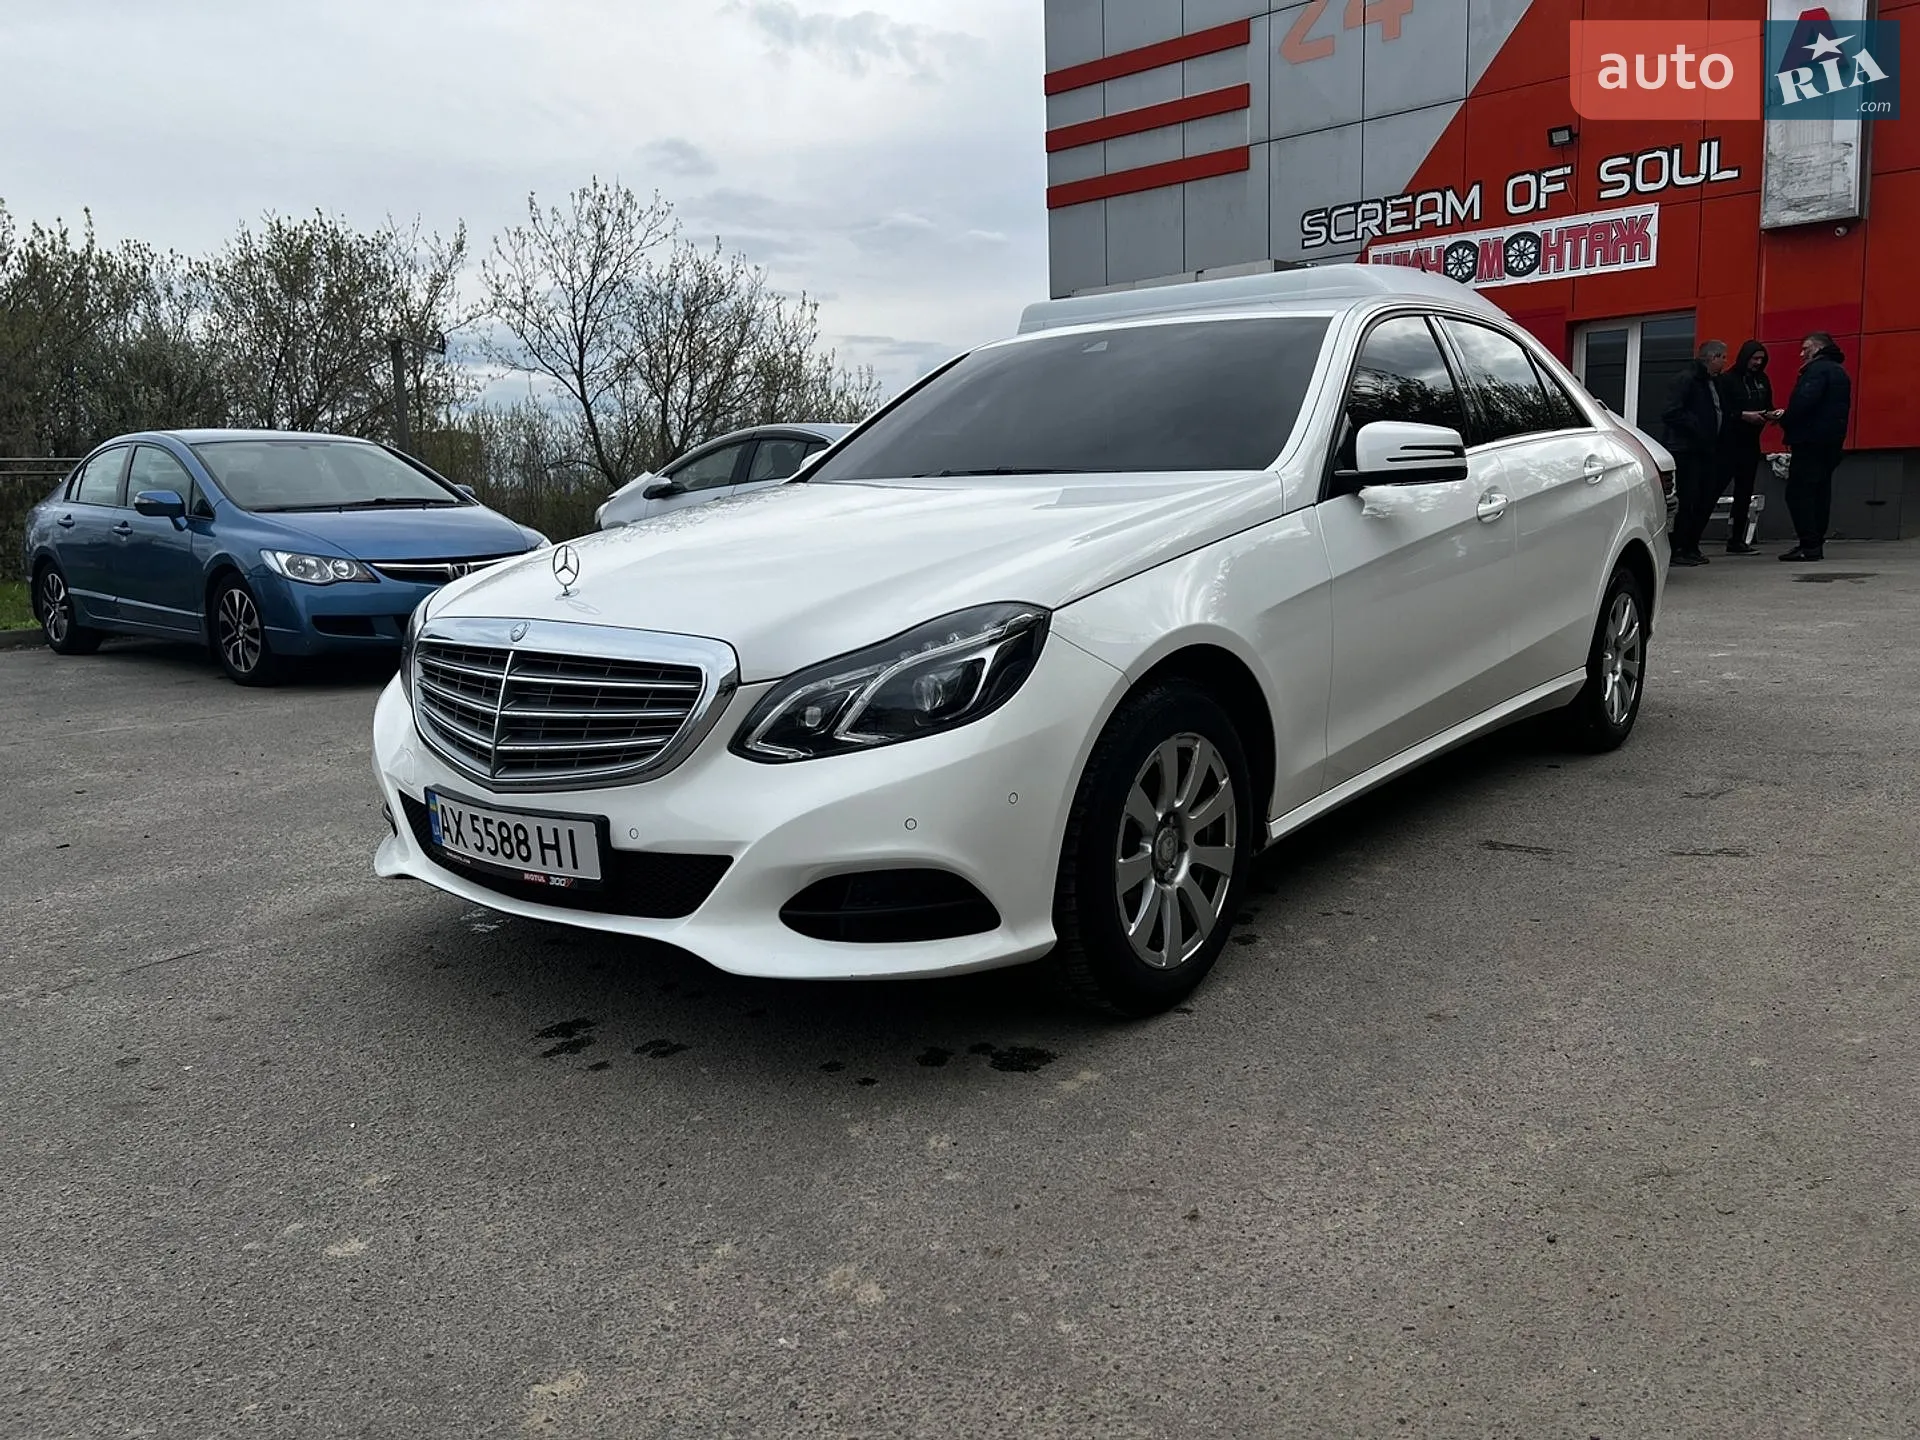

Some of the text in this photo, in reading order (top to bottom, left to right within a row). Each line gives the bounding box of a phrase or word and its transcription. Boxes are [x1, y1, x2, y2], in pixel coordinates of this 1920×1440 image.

[1300, 138, 1741, 250] SCREAM OF SOUL
[1372, 213, 1653, 283] НОМОНТАЖ
[440, 803, 579, 870] AX 5588 HI
